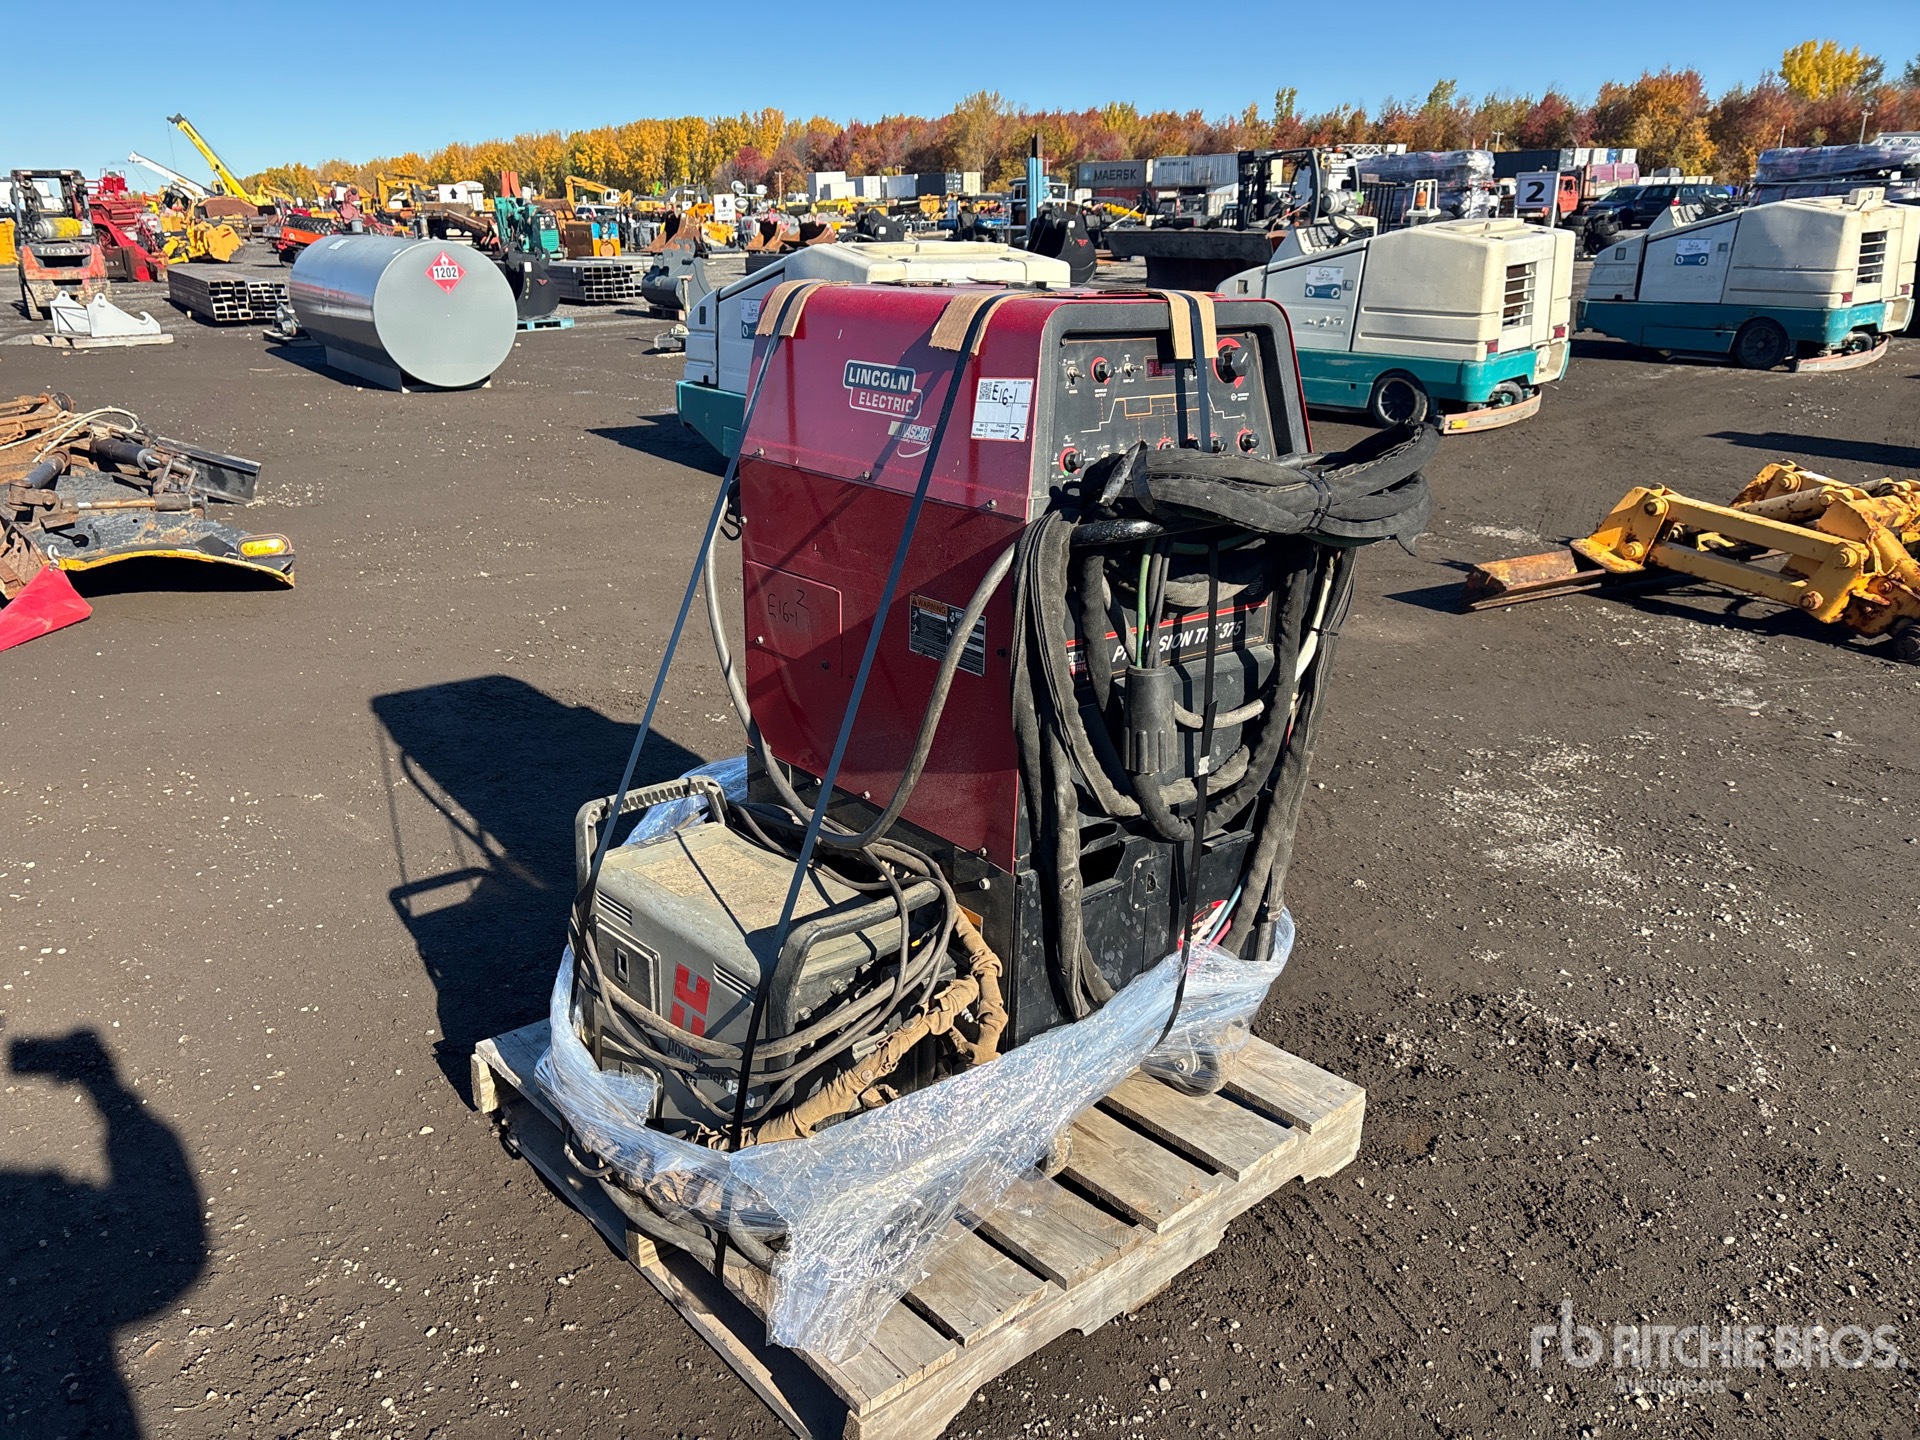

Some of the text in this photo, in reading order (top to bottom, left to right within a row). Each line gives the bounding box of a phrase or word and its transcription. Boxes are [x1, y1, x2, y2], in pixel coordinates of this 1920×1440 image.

[1093, 169, 1137, 180] MAERSK
[1526, 181, 1545, 202] 2
[435, 267, 457, 278] 1202
[848, 366, 910, 391] LINCOLN
[858, 391, 914, 413] ELECTRIC
[991, 384, 1018, 406] E16-1
[900, 422, 931, 442] NASCAR
[1010, 426, 1020, 440] 2
[796, 589, 810, 611] 2
[918, 598, 947, 615] WARNING
[1219, 621, 1244, 639] 375
